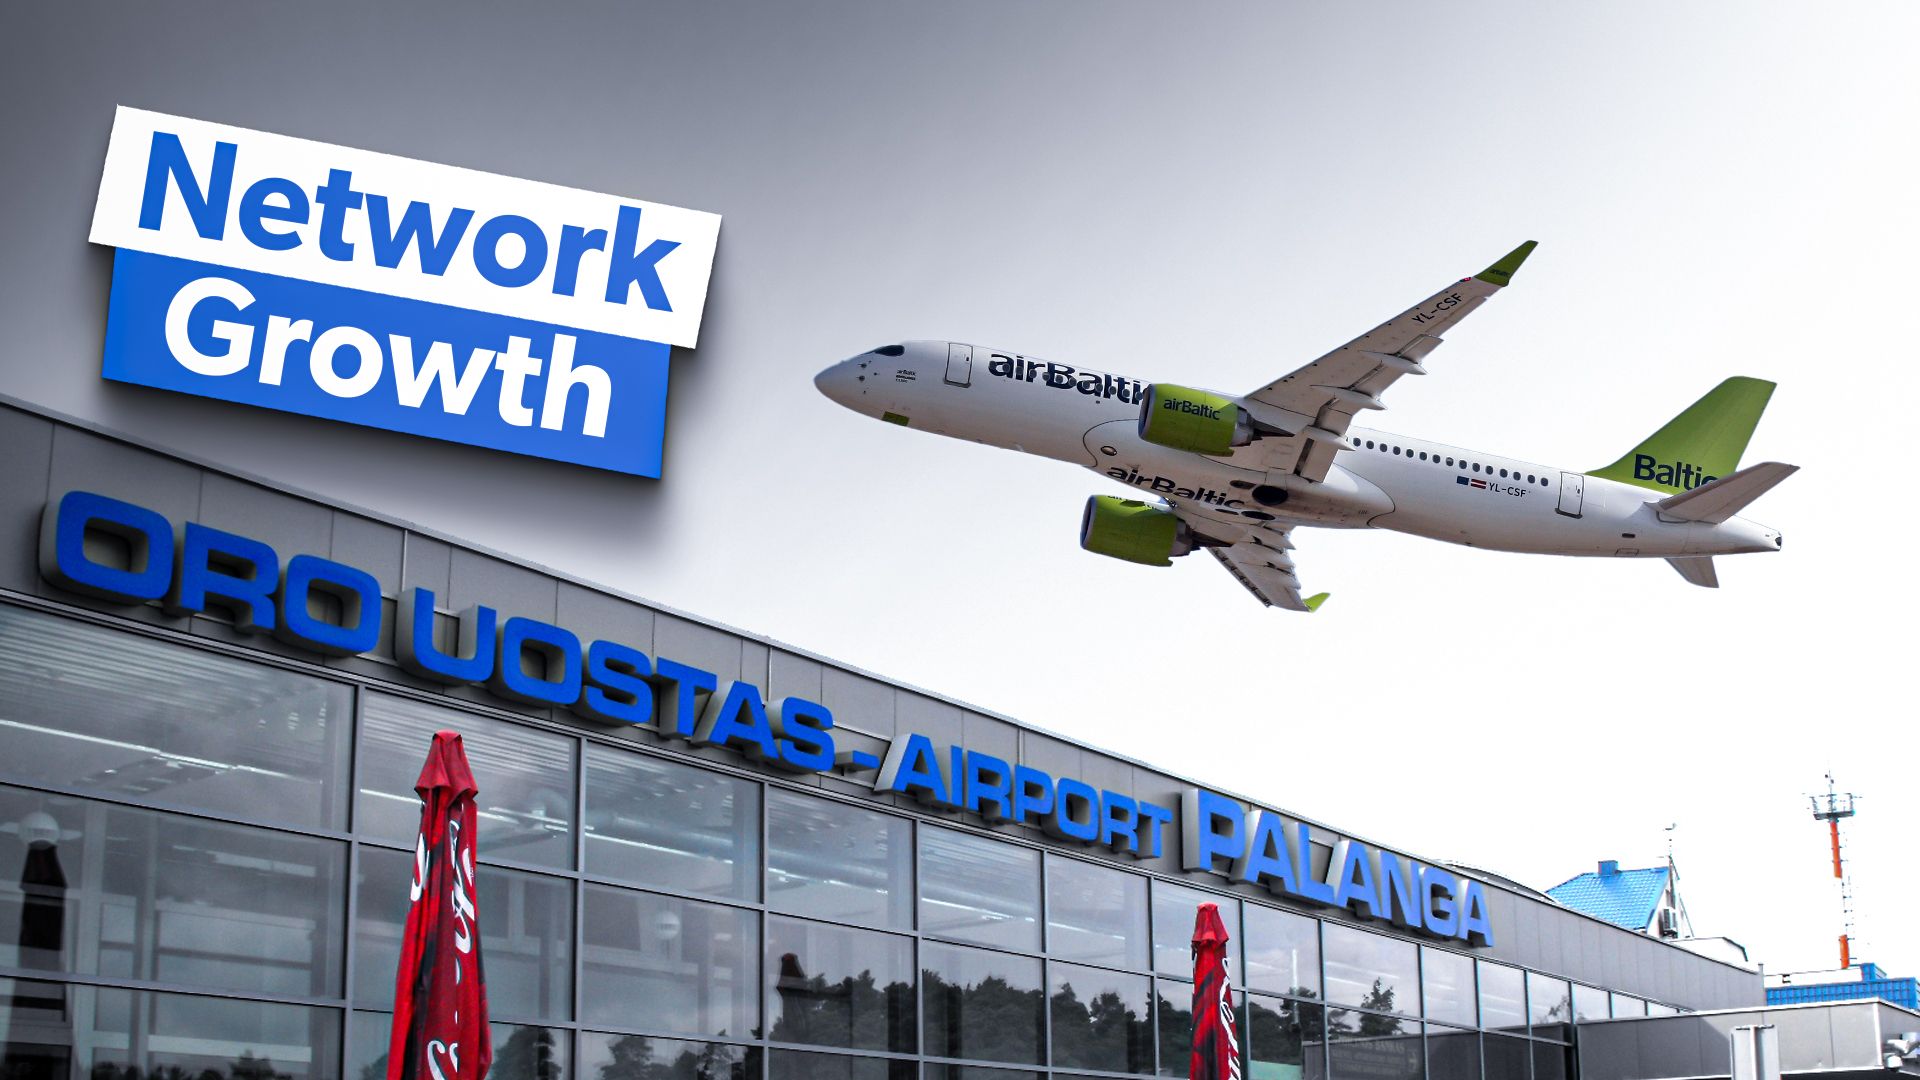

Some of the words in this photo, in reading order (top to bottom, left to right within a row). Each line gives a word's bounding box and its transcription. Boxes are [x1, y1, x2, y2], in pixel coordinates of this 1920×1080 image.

[1411, 292, 1462, 324] YL-CSF
[988, 353, 1141, 406] airBalti
[1163, 398, 1221, 421] airBaltic
[1106, 466, 1245, 509] airBaltic
[1489, 482, 1527, 498] YL-CSF
[52, 490, 384, 655] ORO
[402, 586, 836, 772] UOSTAS
[890, 733, 1174, 859] AIRPORT
[1194, 788, 1496, 949] PALANGA
